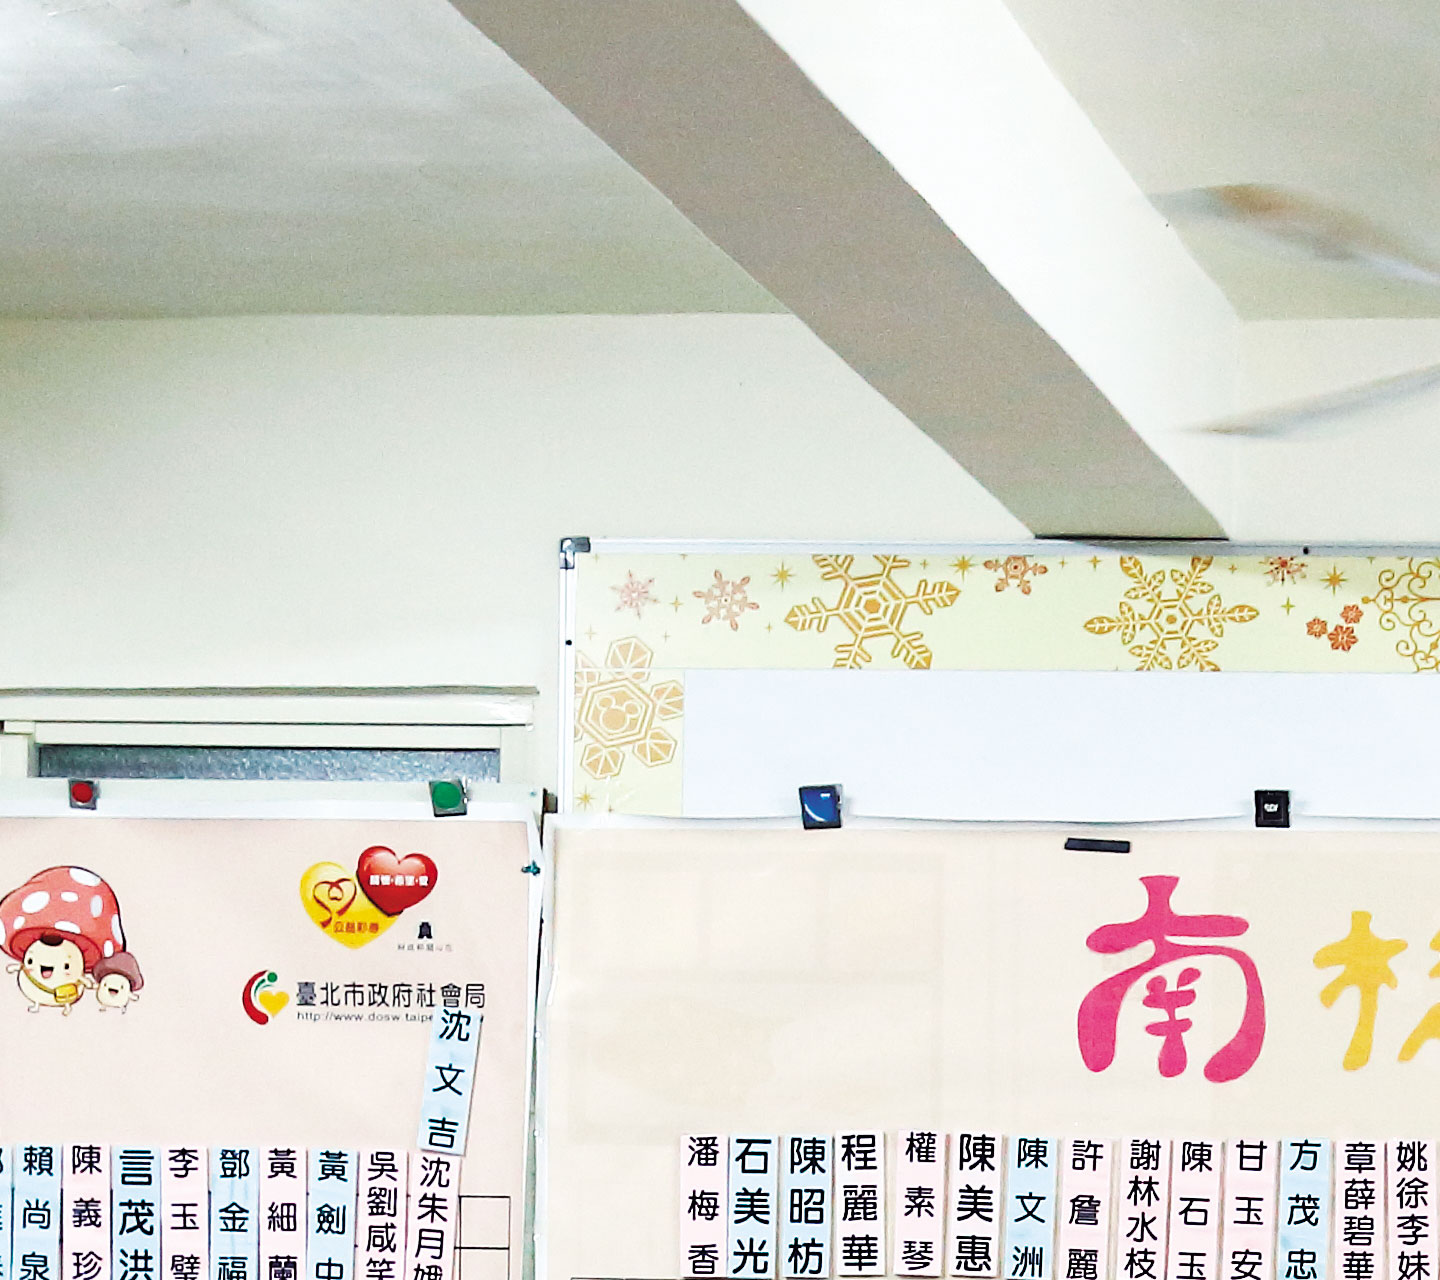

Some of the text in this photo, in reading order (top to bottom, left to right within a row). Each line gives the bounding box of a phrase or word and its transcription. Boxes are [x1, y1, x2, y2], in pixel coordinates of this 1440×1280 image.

[297, 981, 485, 1008] 臺北市政府社會局
[428, 1009, 471, 1148] 沈文吉
[72, 1145, 103, 1280] 陳義珍
[688, 1136, 720, 1274] 潘梅香
[732, 1139, 772, 1274] 石美光
[788, 1137, 826, 1274] 陳昭枋
[841, 1135, 878, 1271] 程麗華
[902, 1132, 937, 1270] 權素琴
[956, 1134, 995, 1271] 陳美惠
[1012, 1138, 1048, 1278] 陳文洲
[1066, 1140, 1104, 1280] 許詹麗
[1124, 1139, 1161, 1279] 謝林水枝
[1176, 1142, 1213, 1280] 陳石玉
[1231, 1140, 1267, 1280] 甘玉安
[1285, 1139, 1321, 1279] 方茂忠
